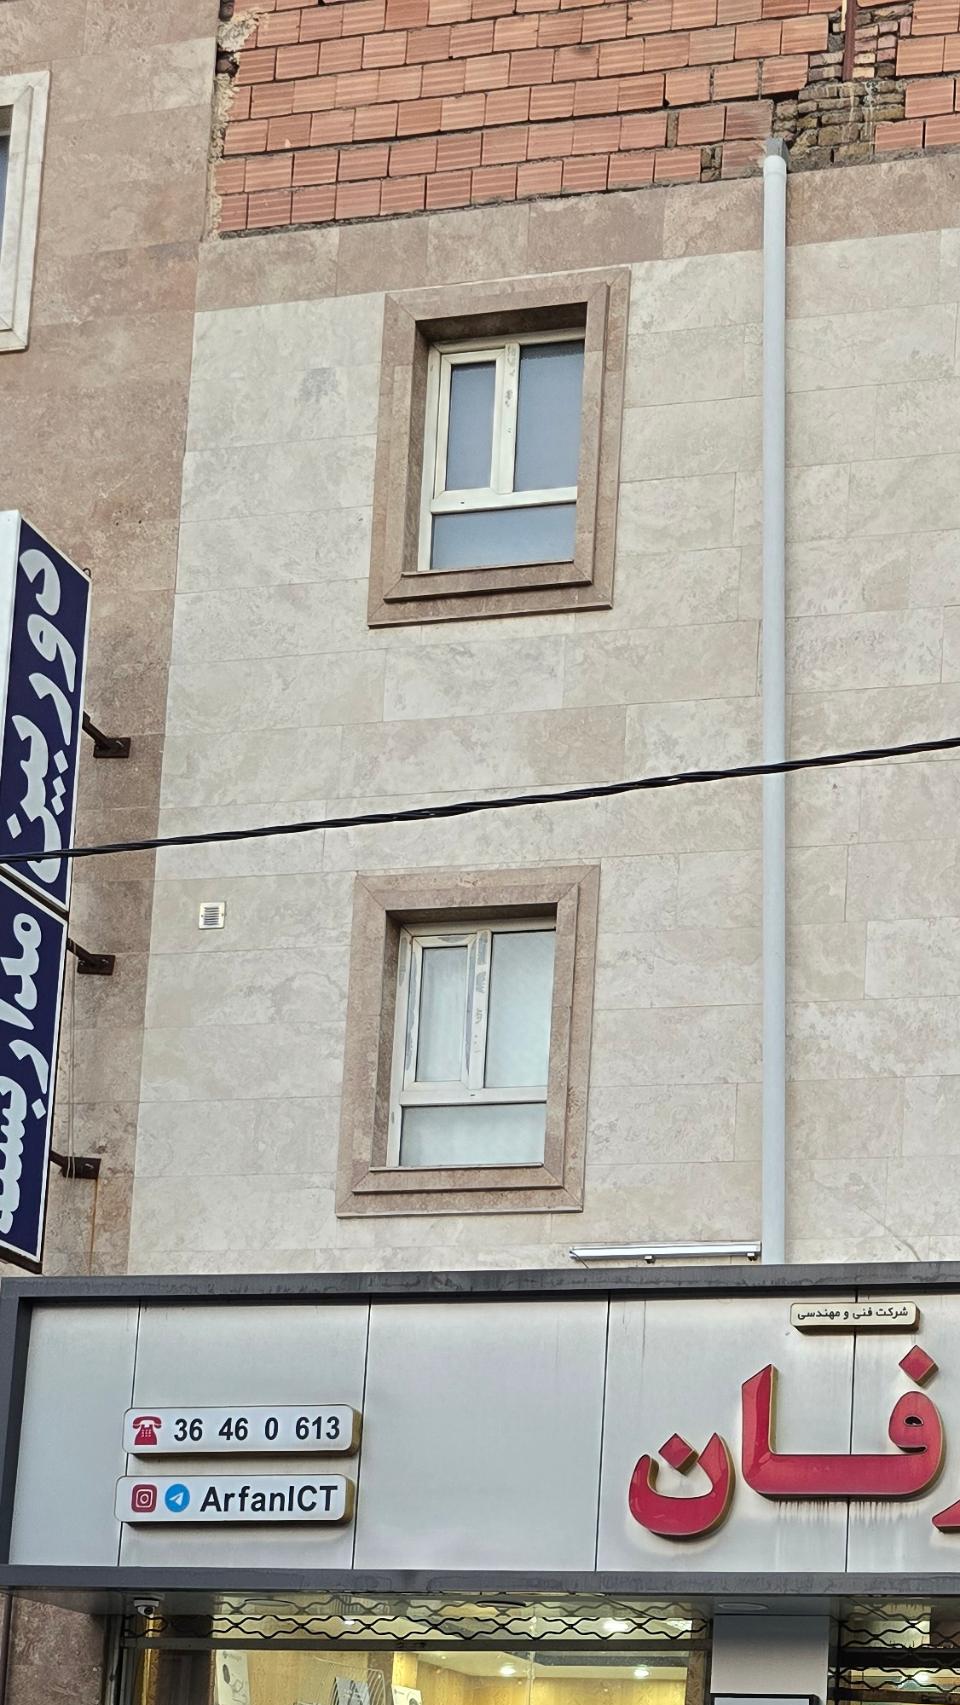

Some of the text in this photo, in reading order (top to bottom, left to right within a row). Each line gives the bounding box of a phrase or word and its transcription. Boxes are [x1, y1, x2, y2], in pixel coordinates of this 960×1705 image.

[6, 549, 77, 883] دوربین
[797, 1307, 908, 1320] شرکت فنی و مهندسی
[173, 1416, 340, 1442] 36 46 0 613
[199, 1484, 338, 1512] ArfanICT
